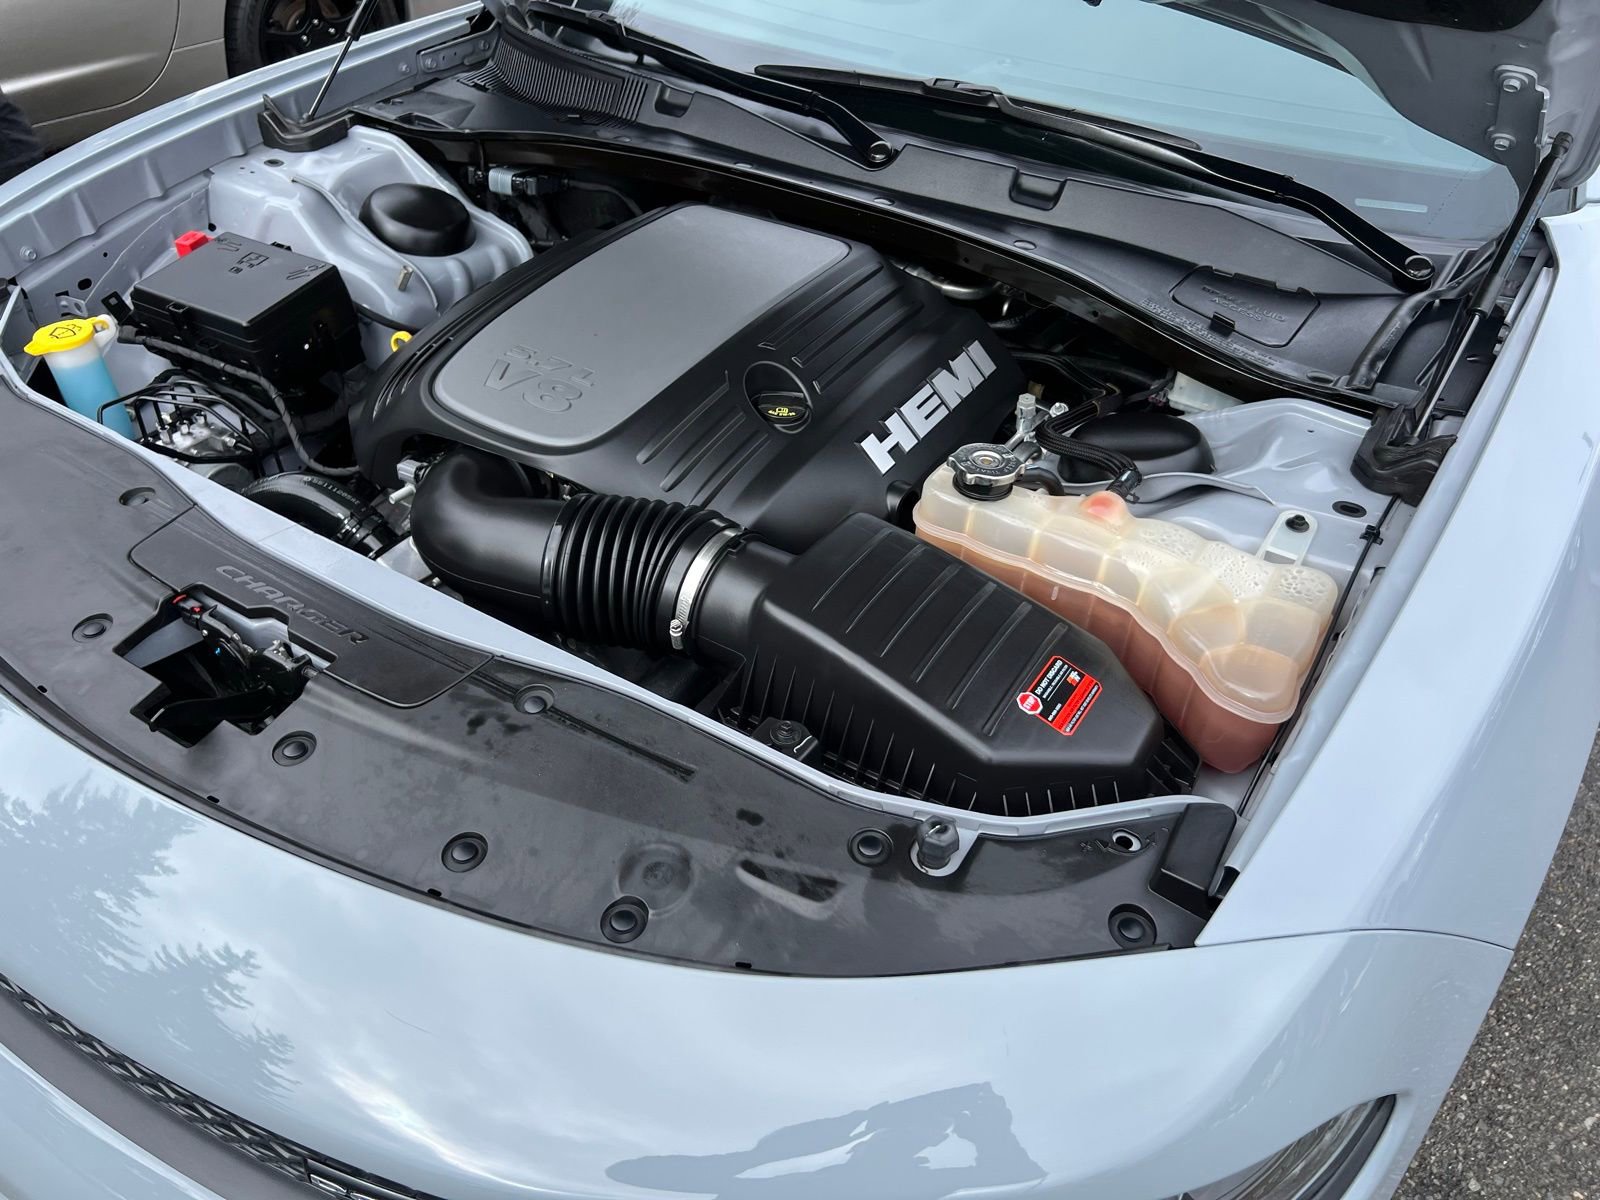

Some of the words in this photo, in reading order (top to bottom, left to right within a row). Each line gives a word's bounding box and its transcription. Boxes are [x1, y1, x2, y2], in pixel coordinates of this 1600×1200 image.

[1210, 297, 1262, 321] ACCESS
[483, 359, 583, 413] V8
[503, 344, 595, 387] 5.7L
[857, 340, 997, 475] HEMI
[216, 565, 369, 645] CHARGER
[1047, 660, 1063, 679] DISCARD
